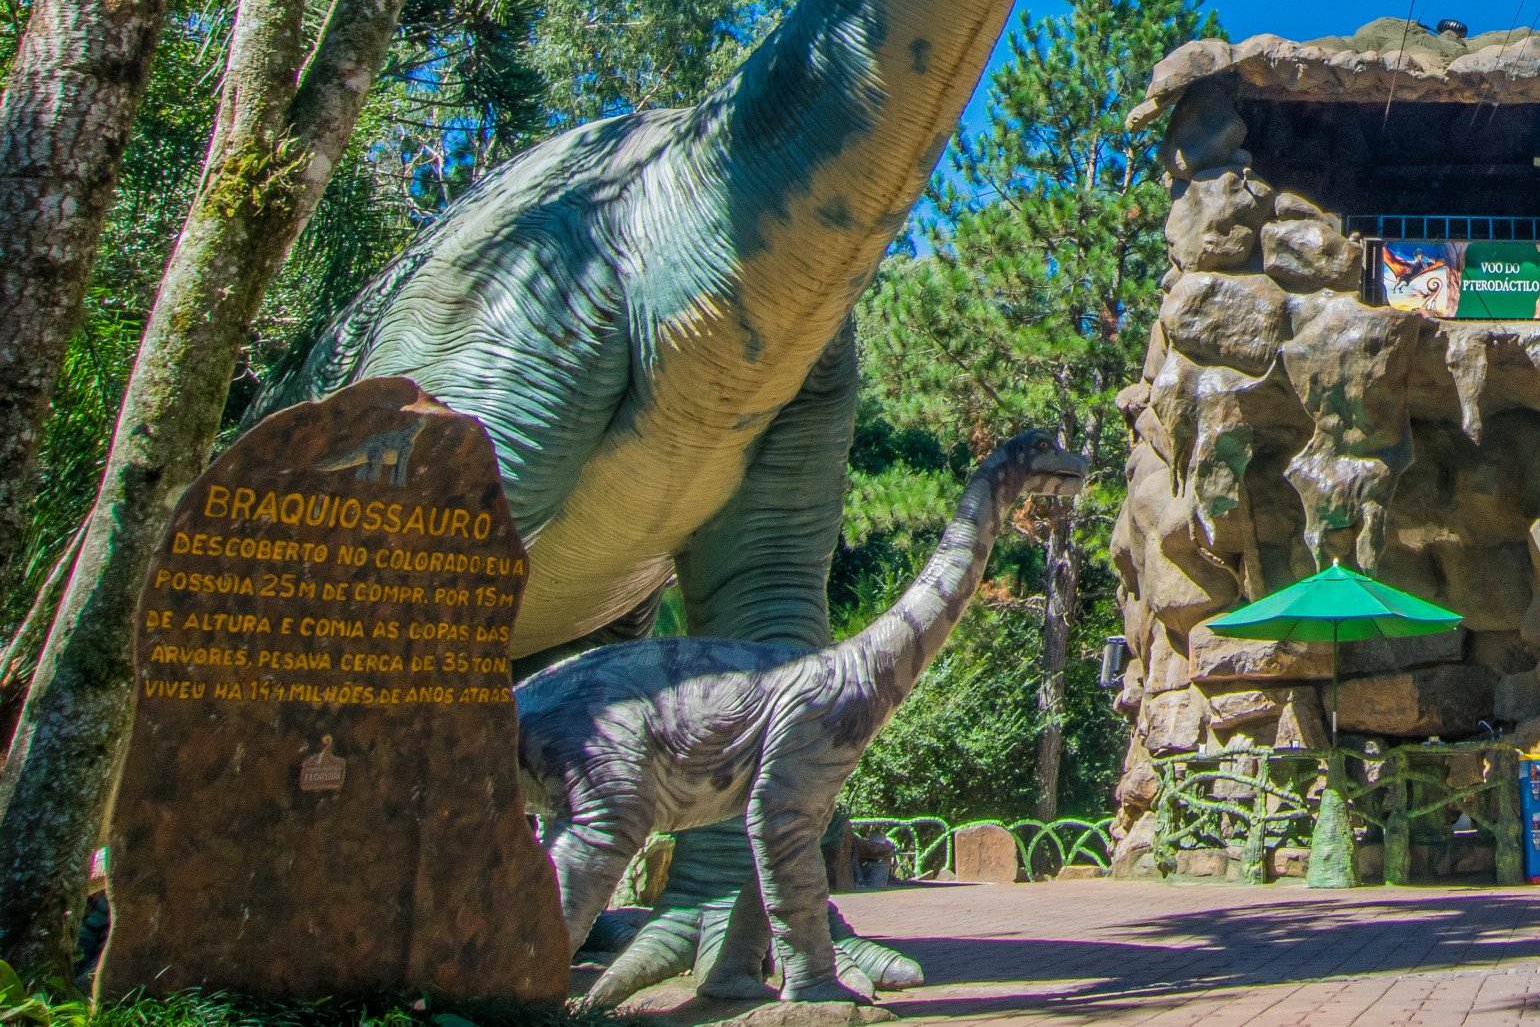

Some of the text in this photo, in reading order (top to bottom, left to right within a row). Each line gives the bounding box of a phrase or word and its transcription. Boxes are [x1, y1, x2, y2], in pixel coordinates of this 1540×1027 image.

[1481, 262, 1520, 274] VOO DO
[1462, 277, 1540, 292] PTERODÁCTILO
[203, 484, 492, 540] BRAQUIOSSAURO
[172, 531, 524, 575] DESCOBERTO NO COLORADO EUA
[154, 569, 255, 596] POSSUIA
[322, 582, 349, 601] DE
[355, 582, 429, 604] COMPR.
[434, 587, 470, 607] POR
[146, 609, 510, 642] DE ALTURA E COMIA AS COPAS DAS
[258, 650, 332, 671] PESAVA
[340, 653, 403, 672] CERCA
[411, 655, 435, 672] DE
[144, 679, 206, 699] VIVEU
[288, 681, 375, 705] MILHÕES
[379, 687, 400, 704] DE
[405, 686, 455, 704] ANOS
